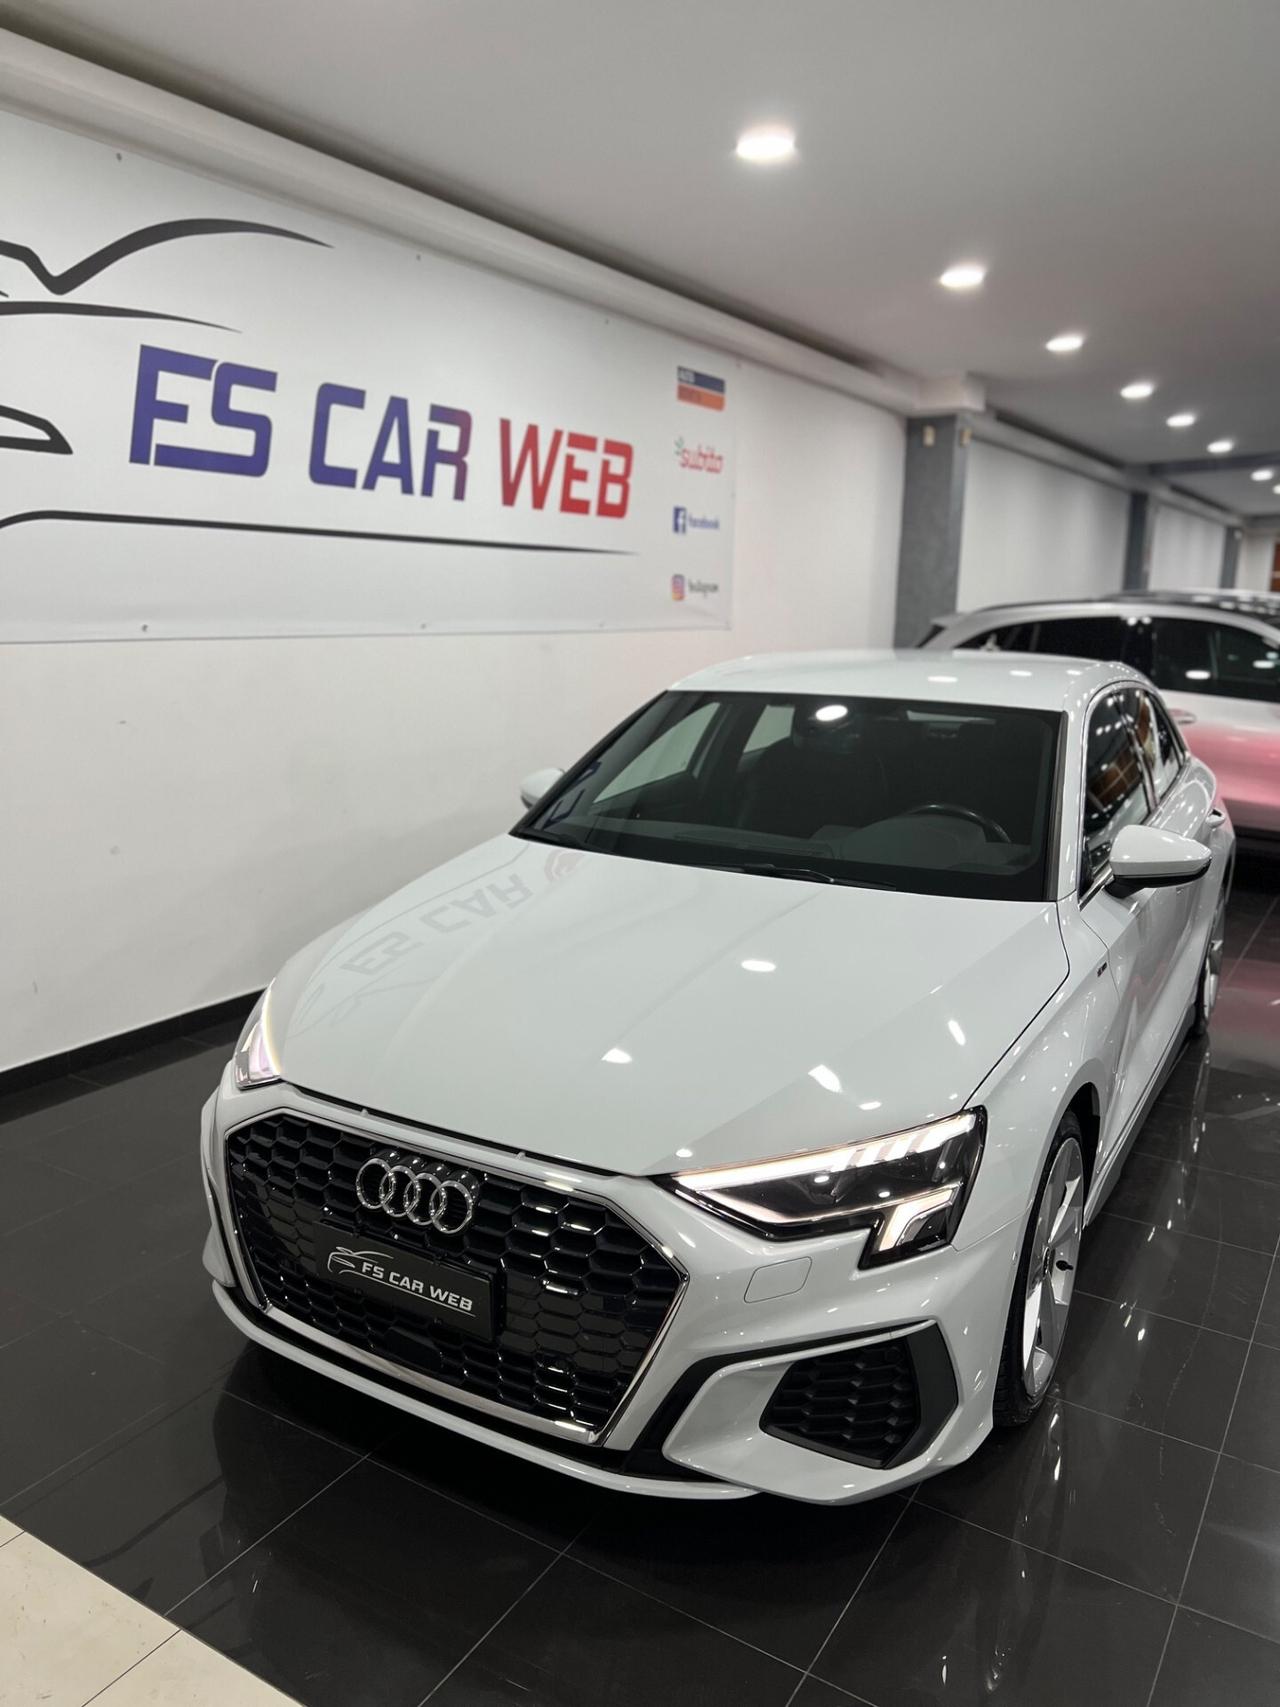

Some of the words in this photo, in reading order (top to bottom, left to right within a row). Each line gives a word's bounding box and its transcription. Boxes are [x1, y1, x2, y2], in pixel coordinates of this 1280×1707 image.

[309, 382, 472, 500] CAR
[499, 418, 633, 519] WEB
[361, 1261, 385, 1279] FS
[388, 1271, 424, 1294] CAR
[429, 1285, 473, 1312] WEB
